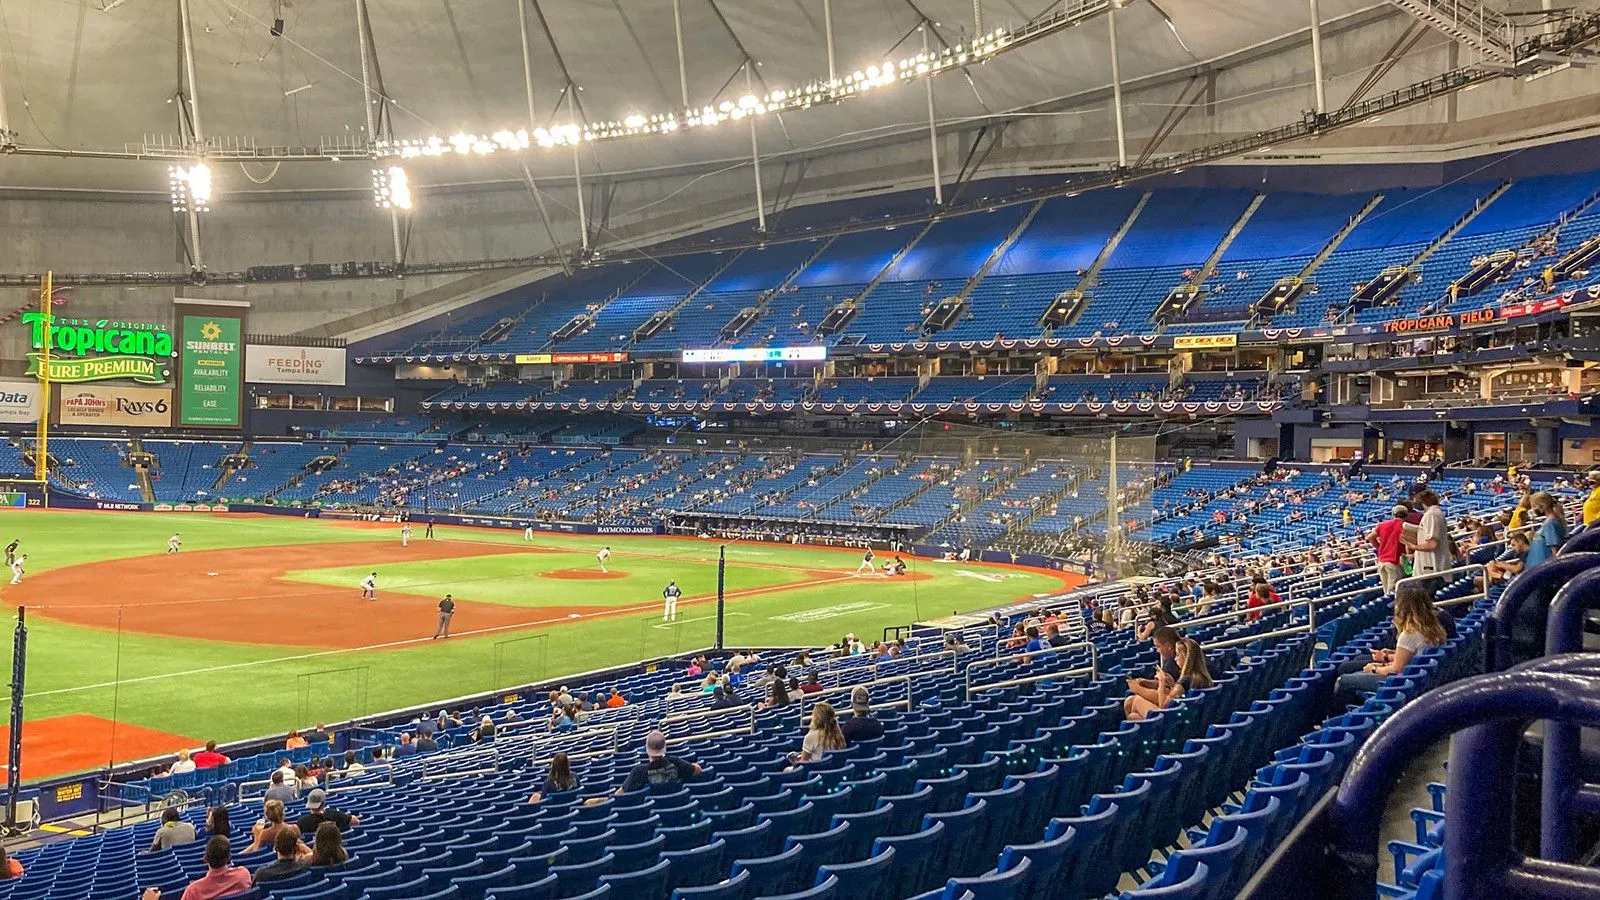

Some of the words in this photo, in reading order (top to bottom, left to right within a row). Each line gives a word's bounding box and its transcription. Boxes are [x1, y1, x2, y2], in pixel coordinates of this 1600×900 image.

[61, 318, 88, 326] THE
[113, 321, 167, 331] ORIGINAL
[1383, 316, 1454, 332] TROPICANA
[1460, 310, 1494, 323] FIELD
[22, 312, 172, 356] Tropicana
[186, 341, 236, 351] SUNBELT
[83, 360, 154, 376] PREMIUM
[268, 358, 322, 368] FEEDING
[193, 368, 229, 376] AVAILABILITY
[194, 384, 226, 392] RELIABILITY
[27, 498, 40, 506] 322
